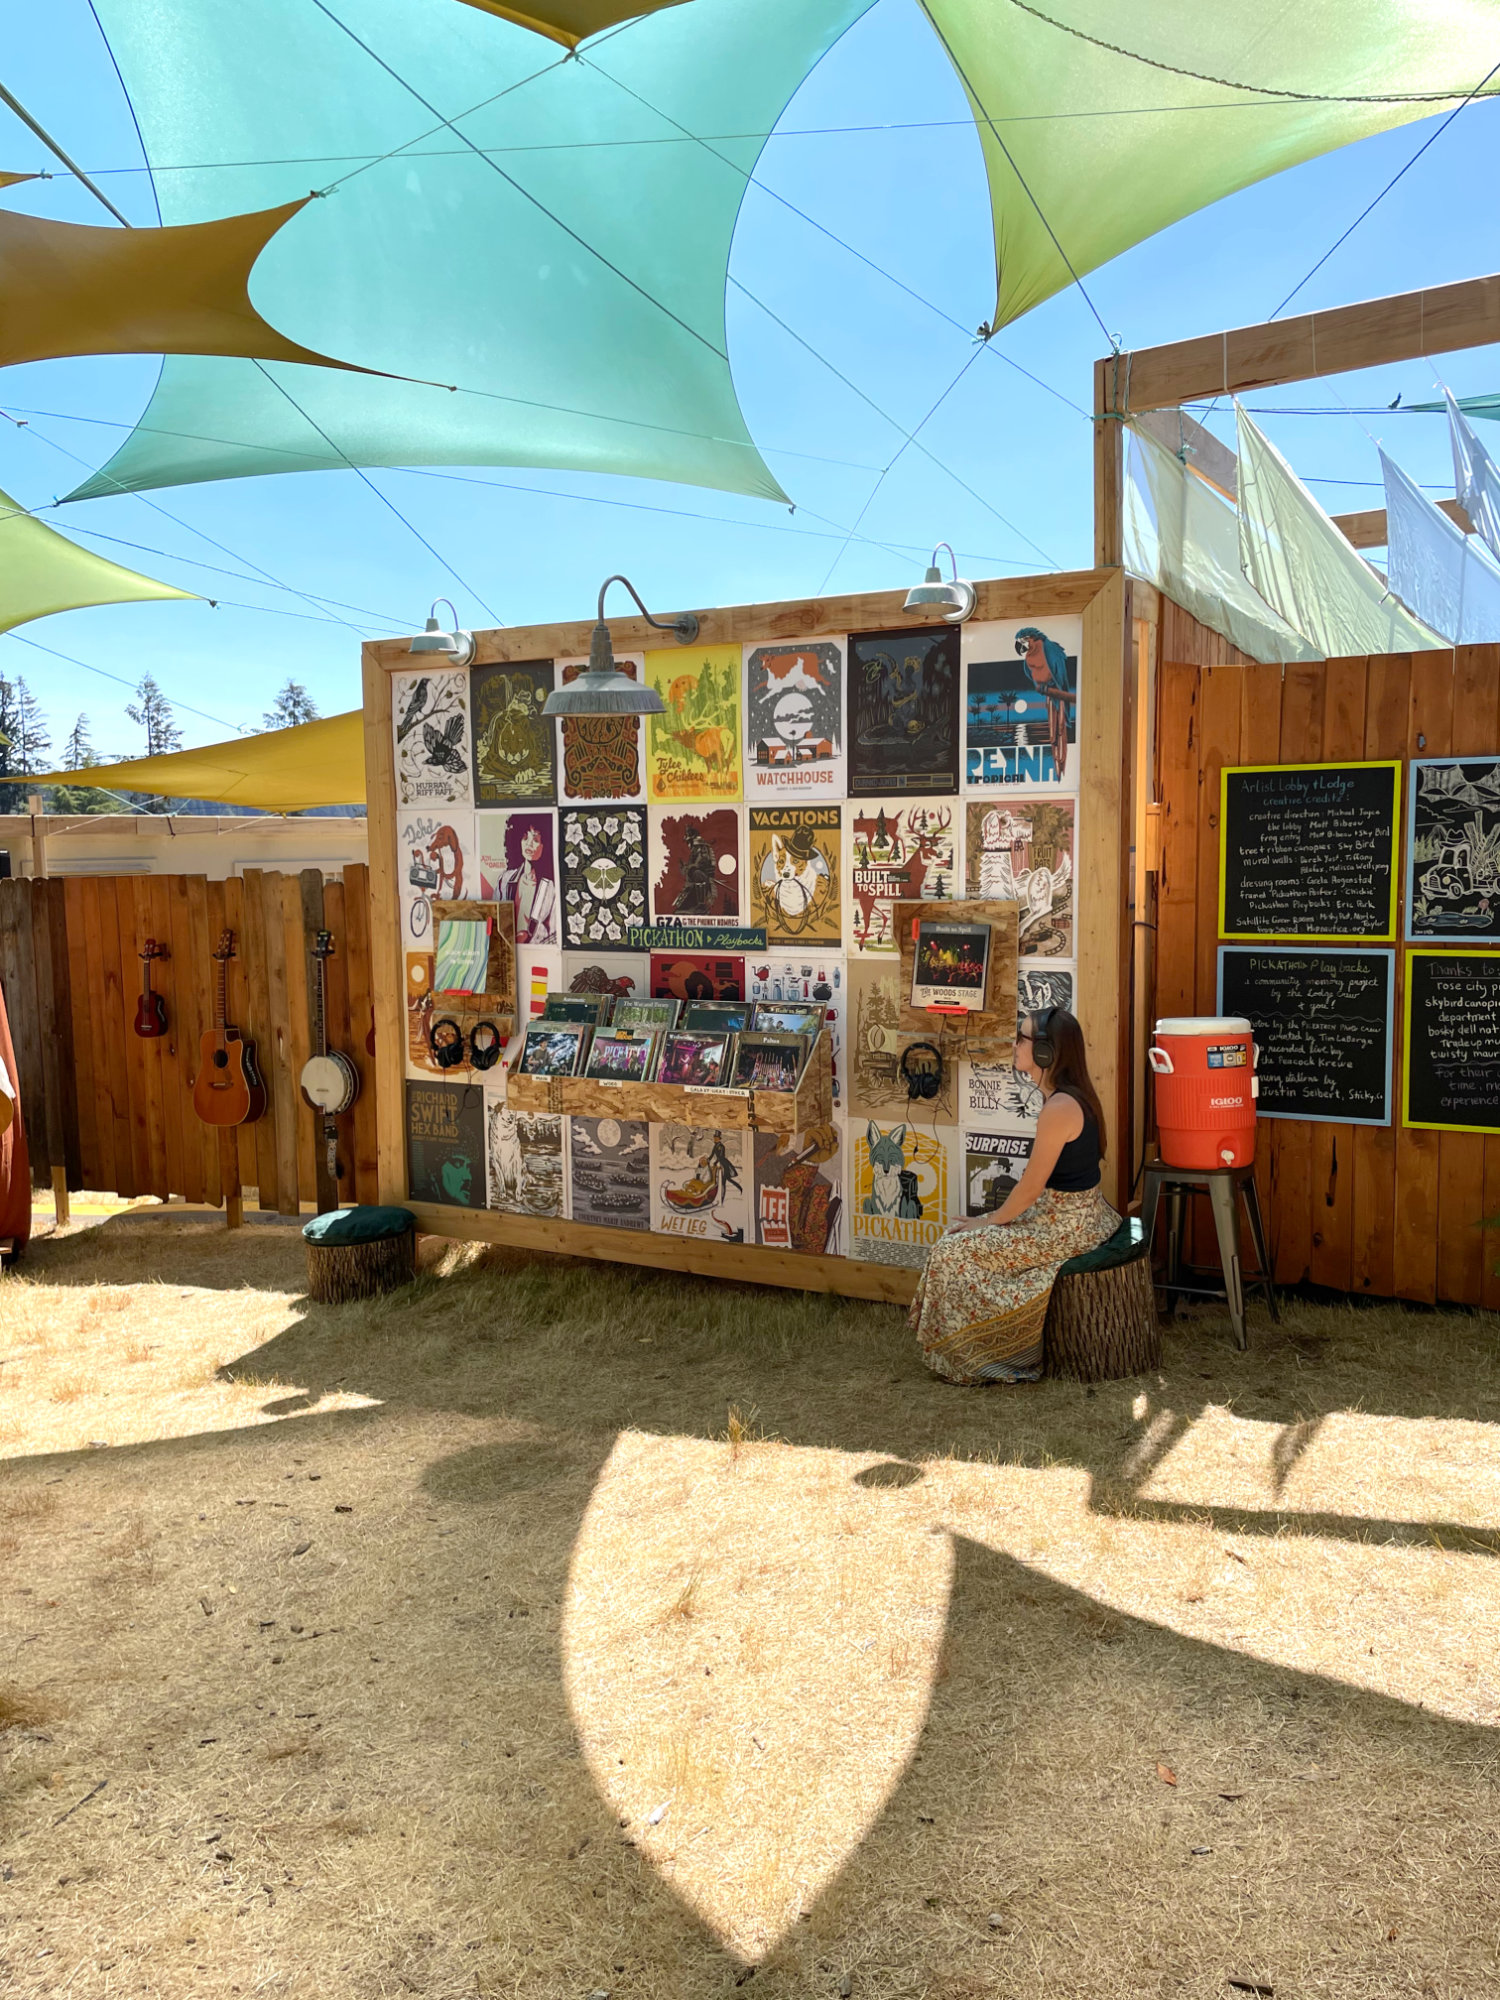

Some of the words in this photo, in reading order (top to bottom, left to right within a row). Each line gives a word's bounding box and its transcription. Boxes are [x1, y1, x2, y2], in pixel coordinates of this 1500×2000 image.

[656, 757, 682, 775] Tyler
[666, 772, 705, 783] Childers
[756, 771, 833, 786] WATCHHOUSE
[416, 782, 448, 790] HURRAY
[416, 789, 433, 797] RIFF
[435, 788, 454, 796] RAFF
[1241, 777, 1276, 793] Artist
[1279, 777, 1310, 797] Lobby
[1319, 776, 1355, 796] Lodge
[1263, 795, 1302, 806] creative
[752, 809, 839, 827] VACATIONS
[1249, 810, 1281, 821] creative
[1327, 808, 1355, 817] Michael
[1267, 823, 1281, 831] the
[1309, 820, 1328, 829] Matt
[1260, 833, 1278, 847] frog
[1374, 826, 1390, 837] Bird
[1033, 847, 1052, 859] FRUIT
[1239, 847, 1259, 855] tree
[1266, 843, 1293, 853] ribbon
[1355, 839, 1376, 849] Bird
[1034, 858, 1051, 869] BATS
[1243, 855, 1270, 866] mural
[854, 870, 890, 884] BUILT
[1240, 876, 1274, 892] dressing
[857, 883, 868, 892] TO
[868, 883, 902, 897] SPILL
[1249, 900, 1290, 910] Pickathon
[1356, 900, 1376, 909] Park
[656, 916, 683, 927] GZA
[630, 928, 704, 948] PICKATHON
[713, 933, 764, 949] Playbacks
[1426, 961, 1473, 977] Thanks
[1254, 976, 1301, 988] community
[1348, 978, 1379, 992] project
[1437, 982, 1462, 991] rose
[1466, 980, 1487, 999] city
[932, 988, 956, 997] WOODS
[957, 990, 978, 998] STAGE
[1270, 989, 1281, 1003] by
[1287, 989, 1302, 997] the
[1464, 1000, 1500, 1011] canopi
[1438, 1011, 1497, 1025] department
[1250, 1018, 1270, 1028] hotos
[1272, 1019, 1283, 1033] by
[1287, 1020, 1300, 1030] the
[1428, 1025, 1455, 1038] bosky
[1458, 1024, 1477, 1035] dell
[1268, 1033, 1301, 1041] curated
[1305, 1033, 1316, 1048] by
[1320, 1034, 1334, 1042] Tim
[1267, 1044, 1306, 1054] recorded
[1309, 1043, 1329, 1054] live
[1330, 1046, 1344, 1060] by
[1430, 1049, 1468, 1062] twisty
[1260, 1055, 1275, 1065] the
[1278, 1055, 1316, 1066] Peacock
[1318, 1057, 1353, 1069] Krewe
[1434, 1067, 1455, 1078] for
[1460, 1066, 1493, 1078] their
[968, 1079, 1002, 1090] BONNIE
[1324, 1074, 1337, 1090] by
[417, 1091, 458, 1106] RICHARD
[1261, 1086, 1297, 1097] Justin
[969, 1096, 1001, 1110] BILLY
[1210, 1096, 1243, 1105] IGLOO
[1441, 1095, 1499, 1110] experience
[411, 1103, 457, 1124] SWIFT
[411, 1121, 431, 1136] HEX
[432, 1123, 459, 1138] BAND
[966, 1136, 1029, 1155] SURPRISE
[660, 1215, 686, 1234] WET
[686, 1218, 708, 1236] LEG
